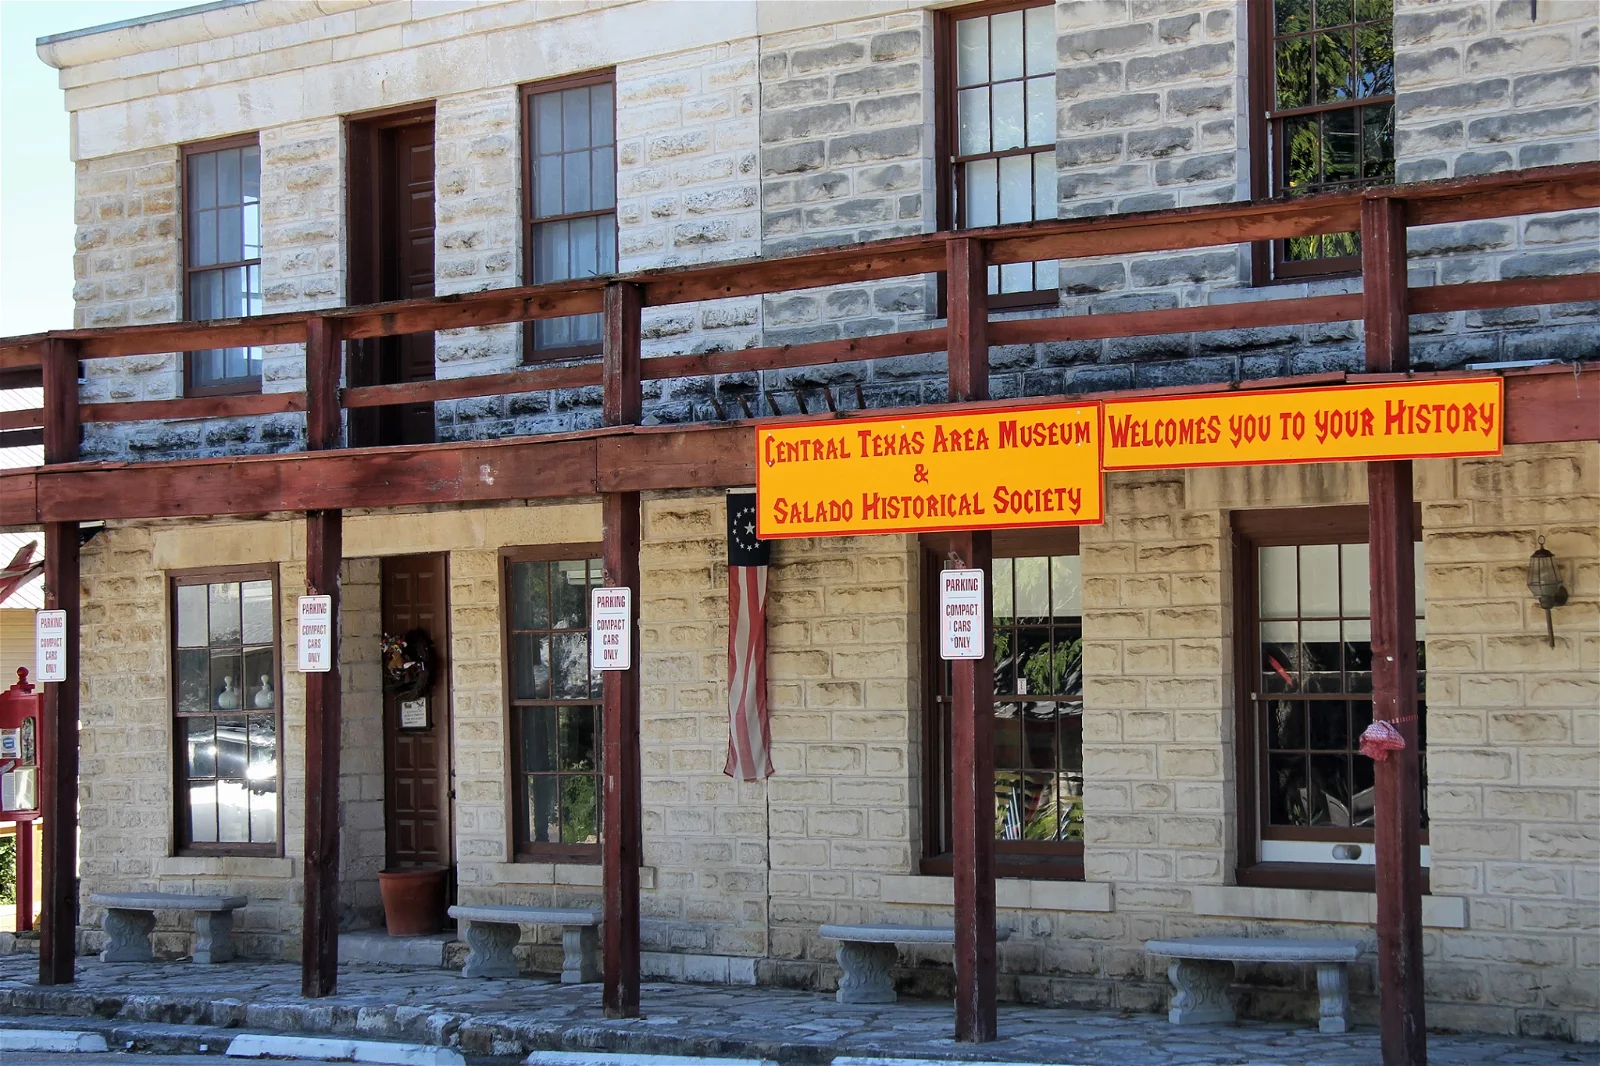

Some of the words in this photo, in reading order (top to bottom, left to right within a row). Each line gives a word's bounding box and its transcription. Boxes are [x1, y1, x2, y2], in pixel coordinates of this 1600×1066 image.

[1108, 414, 1221, 448] WELCOMES
[1228, 413, 1271, 449] YOU
[1279, 410, 1306, 441] TO
[1314, 407, 1375, 445] YOUR
[1384, 399, 1495, 437] HISTORY
[765, 435, 851, 467] CENTRAL
[857, 430, 925, 458] TEXAS
[932, 424, 990, 453] AREA
[998, 420, 1091, 449] MUSEUM
[913, 463, 929, 484] &
[773, 497, 853, 524] SALADO
[861, 491, 986, 521] HISTORICAL
[993, 485, 1082, 516] SOCIETY
[946, 578, 978, 592] PARKING
[597, 595, 626, 608] PARKING
[302, 603, 327, 614] PARKING
[946, 604, 978, 616] COMPACT
[40, 617, 62, 628] PARKING
[597, 618, 625, 631] COMPACT
[953, 620, 972, 632] CARS
[302, 624, 327, 635] COMPACT
[40, 637, 62, 648] COMPACT
[307, 639, 322, 649] CARS
[603, 634, 619, 645] CARS
[954, 636, 971, 649] ONLY
[45, 650, 58, 661] CARS
[308, 652, 321, 663] ONLY
[603, 649, 619, 660] ONLY
[45, 663, 57, 673] ONLY
